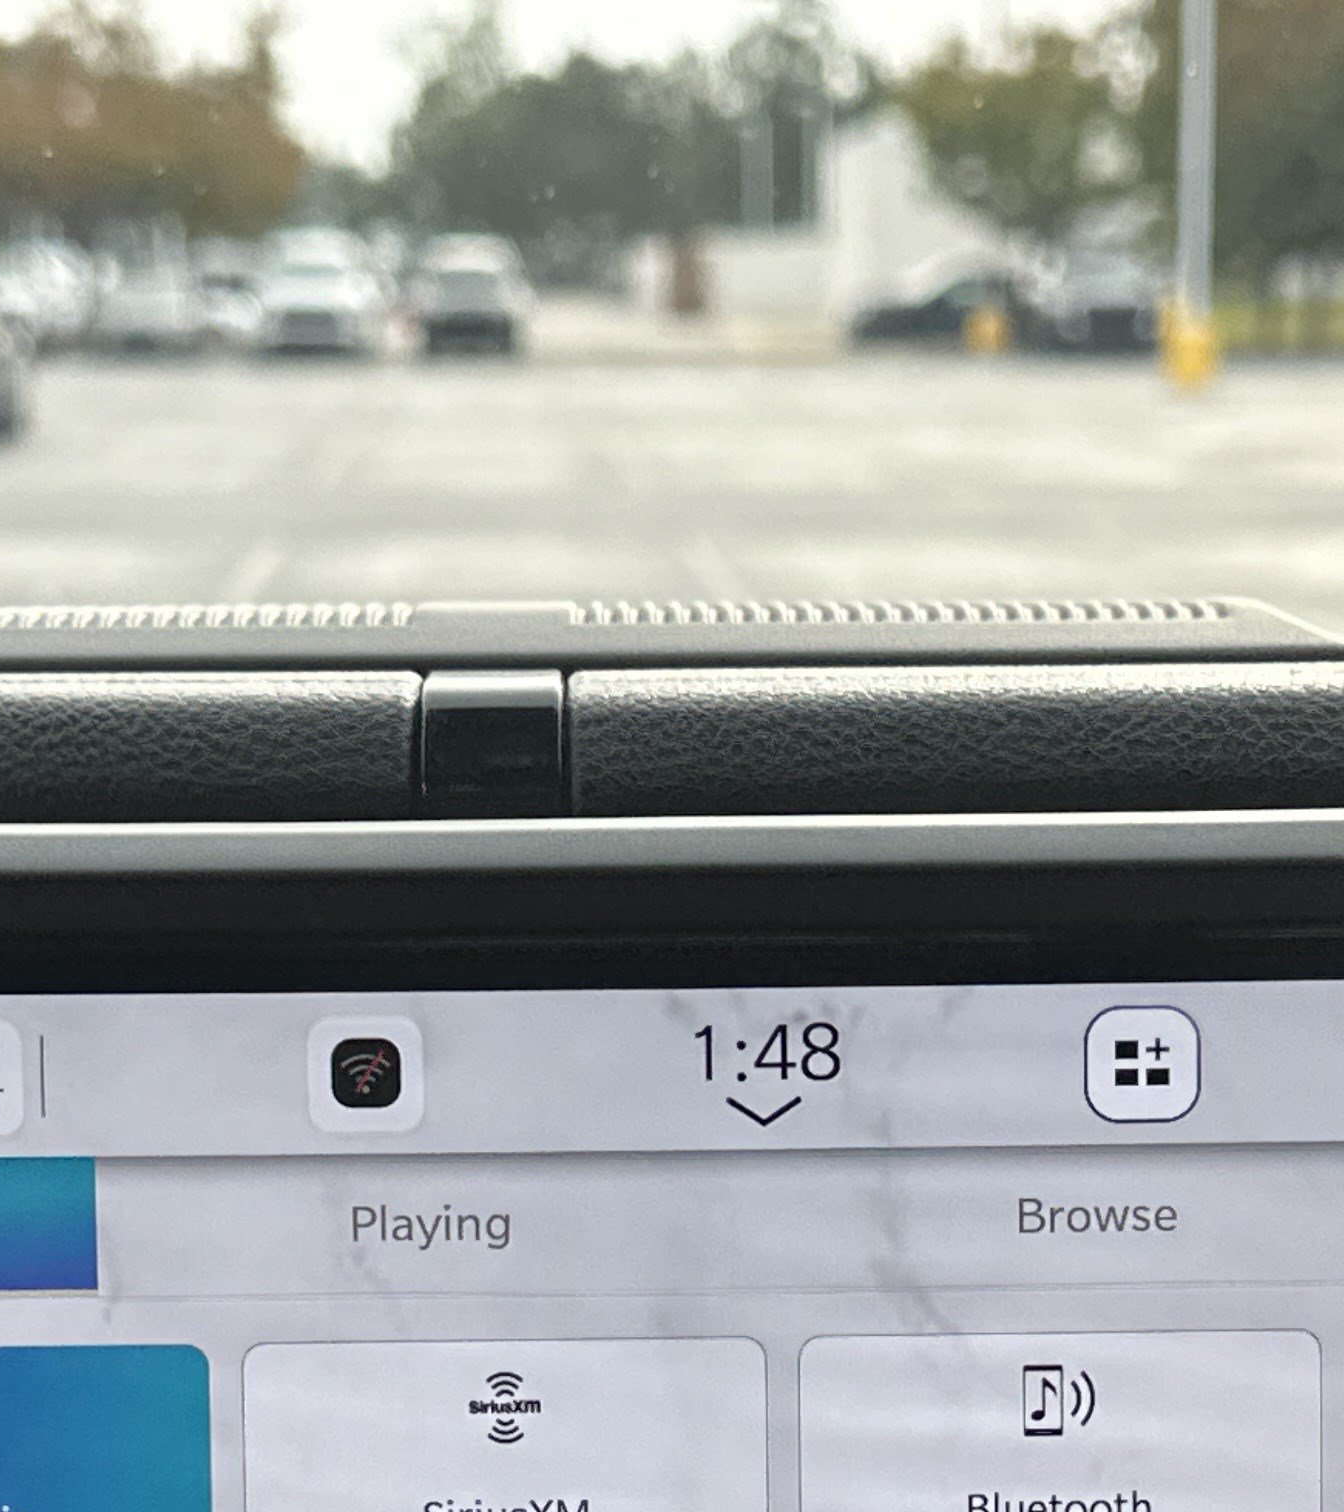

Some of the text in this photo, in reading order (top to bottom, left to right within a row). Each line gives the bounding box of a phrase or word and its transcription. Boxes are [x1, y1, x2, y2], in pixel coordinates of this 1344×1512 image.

[694, 1022, 842, 1082] 1:48
[351, 1205, 513, 1249] Playing
[1017, 1198, 1179, 1233] Browse
